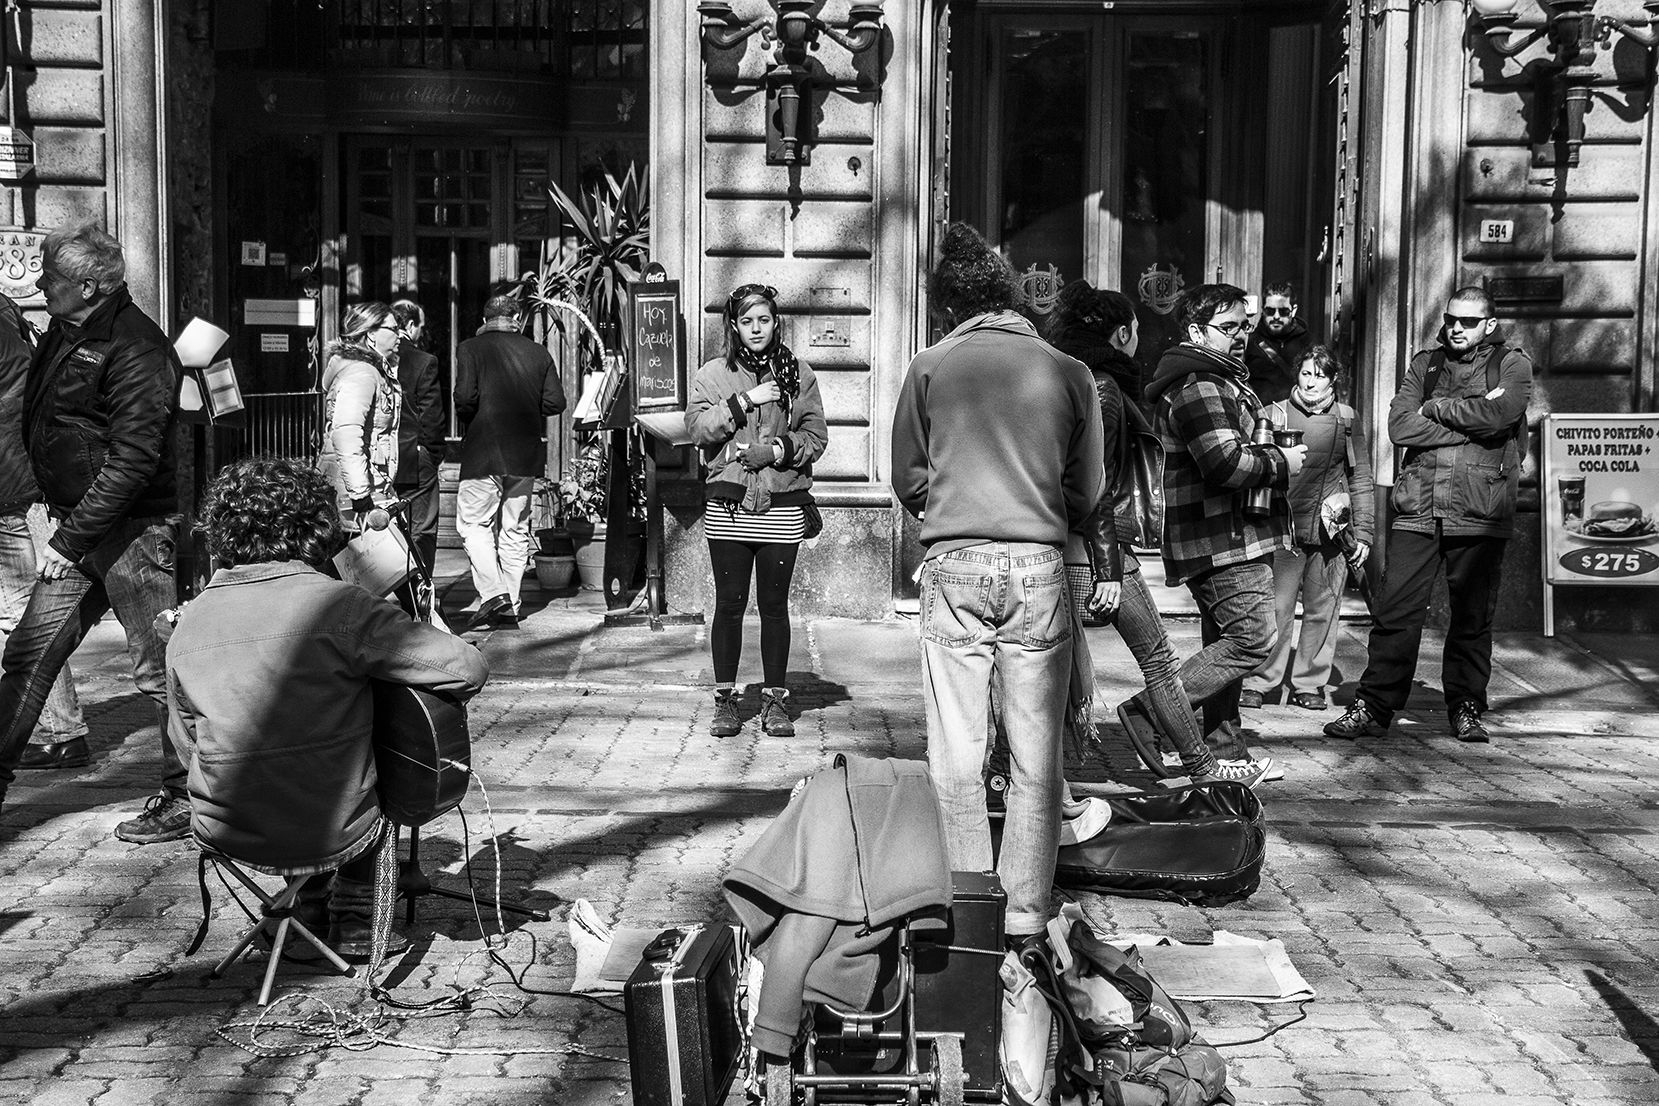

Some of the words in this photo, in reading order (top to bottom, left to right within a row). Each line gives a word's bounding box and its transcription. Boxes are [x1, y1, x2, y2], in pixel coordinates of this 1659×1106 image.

[1488, 225, 1507, 238] 584
[1556, 427, 1601, 440] CHIVITO
[1603, 424, 1654, 440] PORTEÑO
[1567, 444, 1602, 456] PAPAS
[1603, 444, 1643, 456] FRITAS
[1578, 460, 1609, 472] COCA
[1610, 460, 1640, 472] COLA
